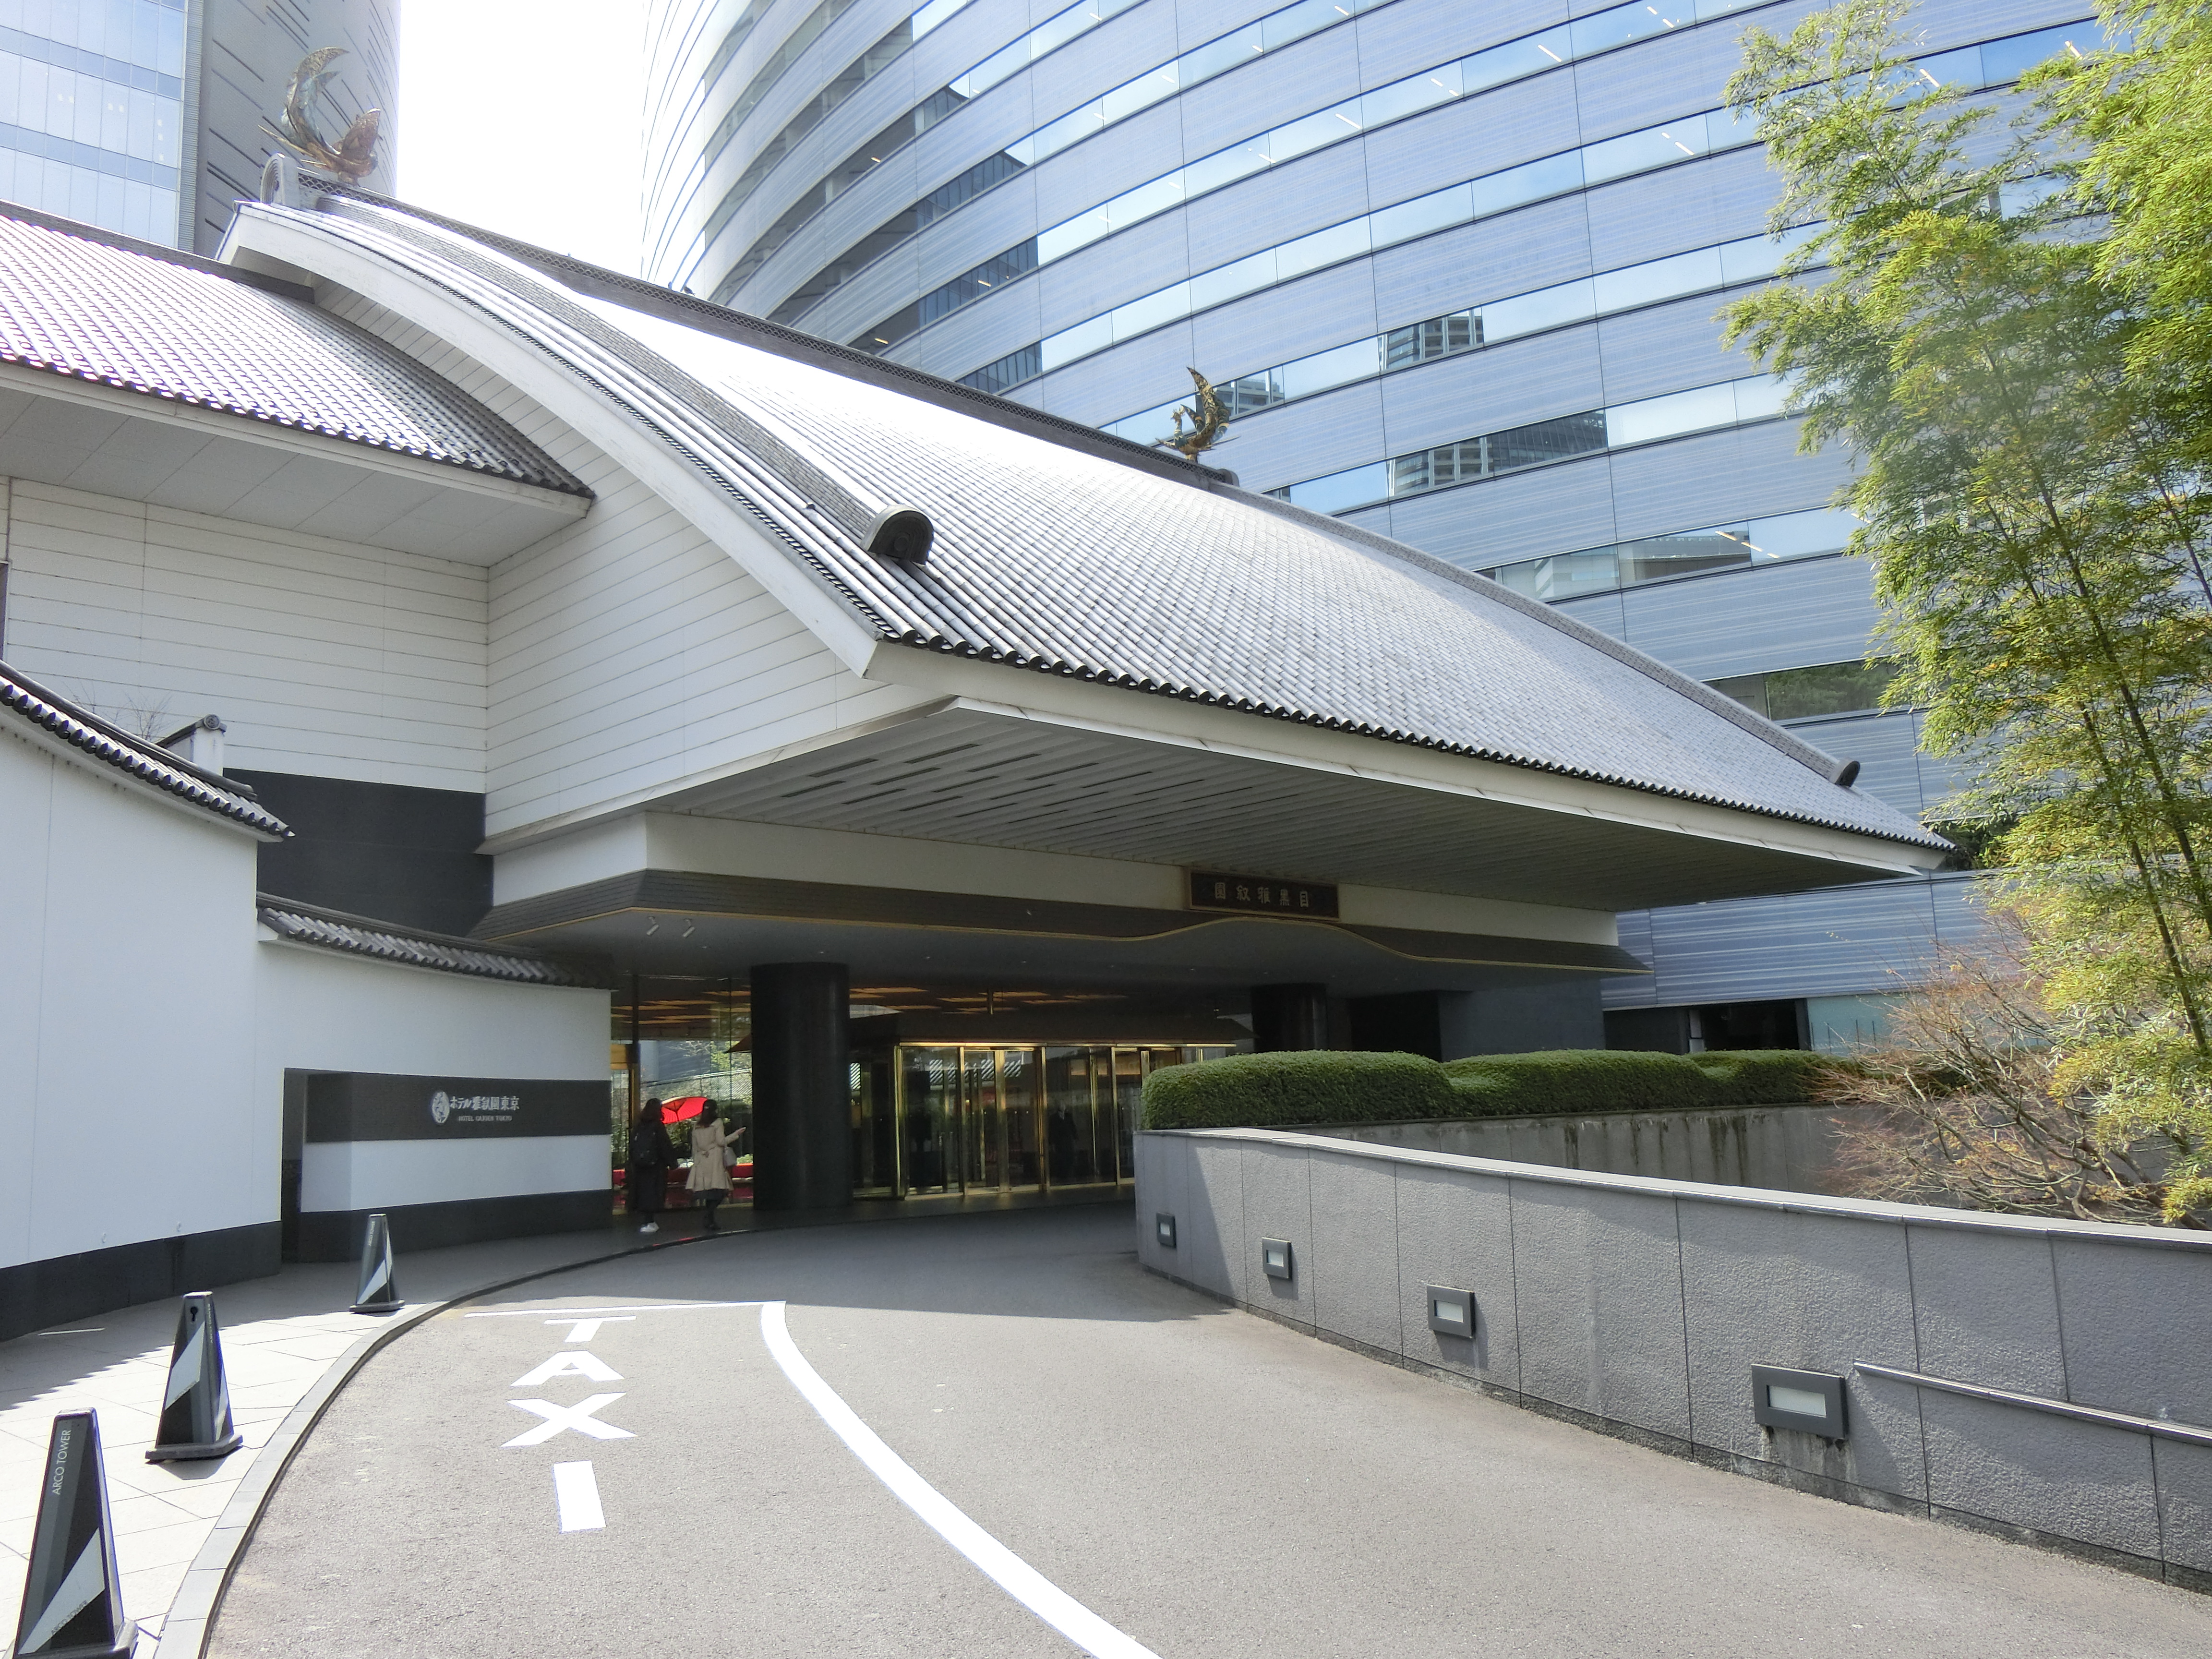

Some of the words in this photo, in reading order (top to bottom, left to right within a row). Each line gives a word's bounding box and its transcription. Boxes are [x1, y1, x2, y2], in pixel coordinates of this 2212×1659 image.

[501, 1315, 638, 1532] TAXI
[57, 1429, 72, 1465] TOWER
[51, 1467, 64, 1495] ARCO
